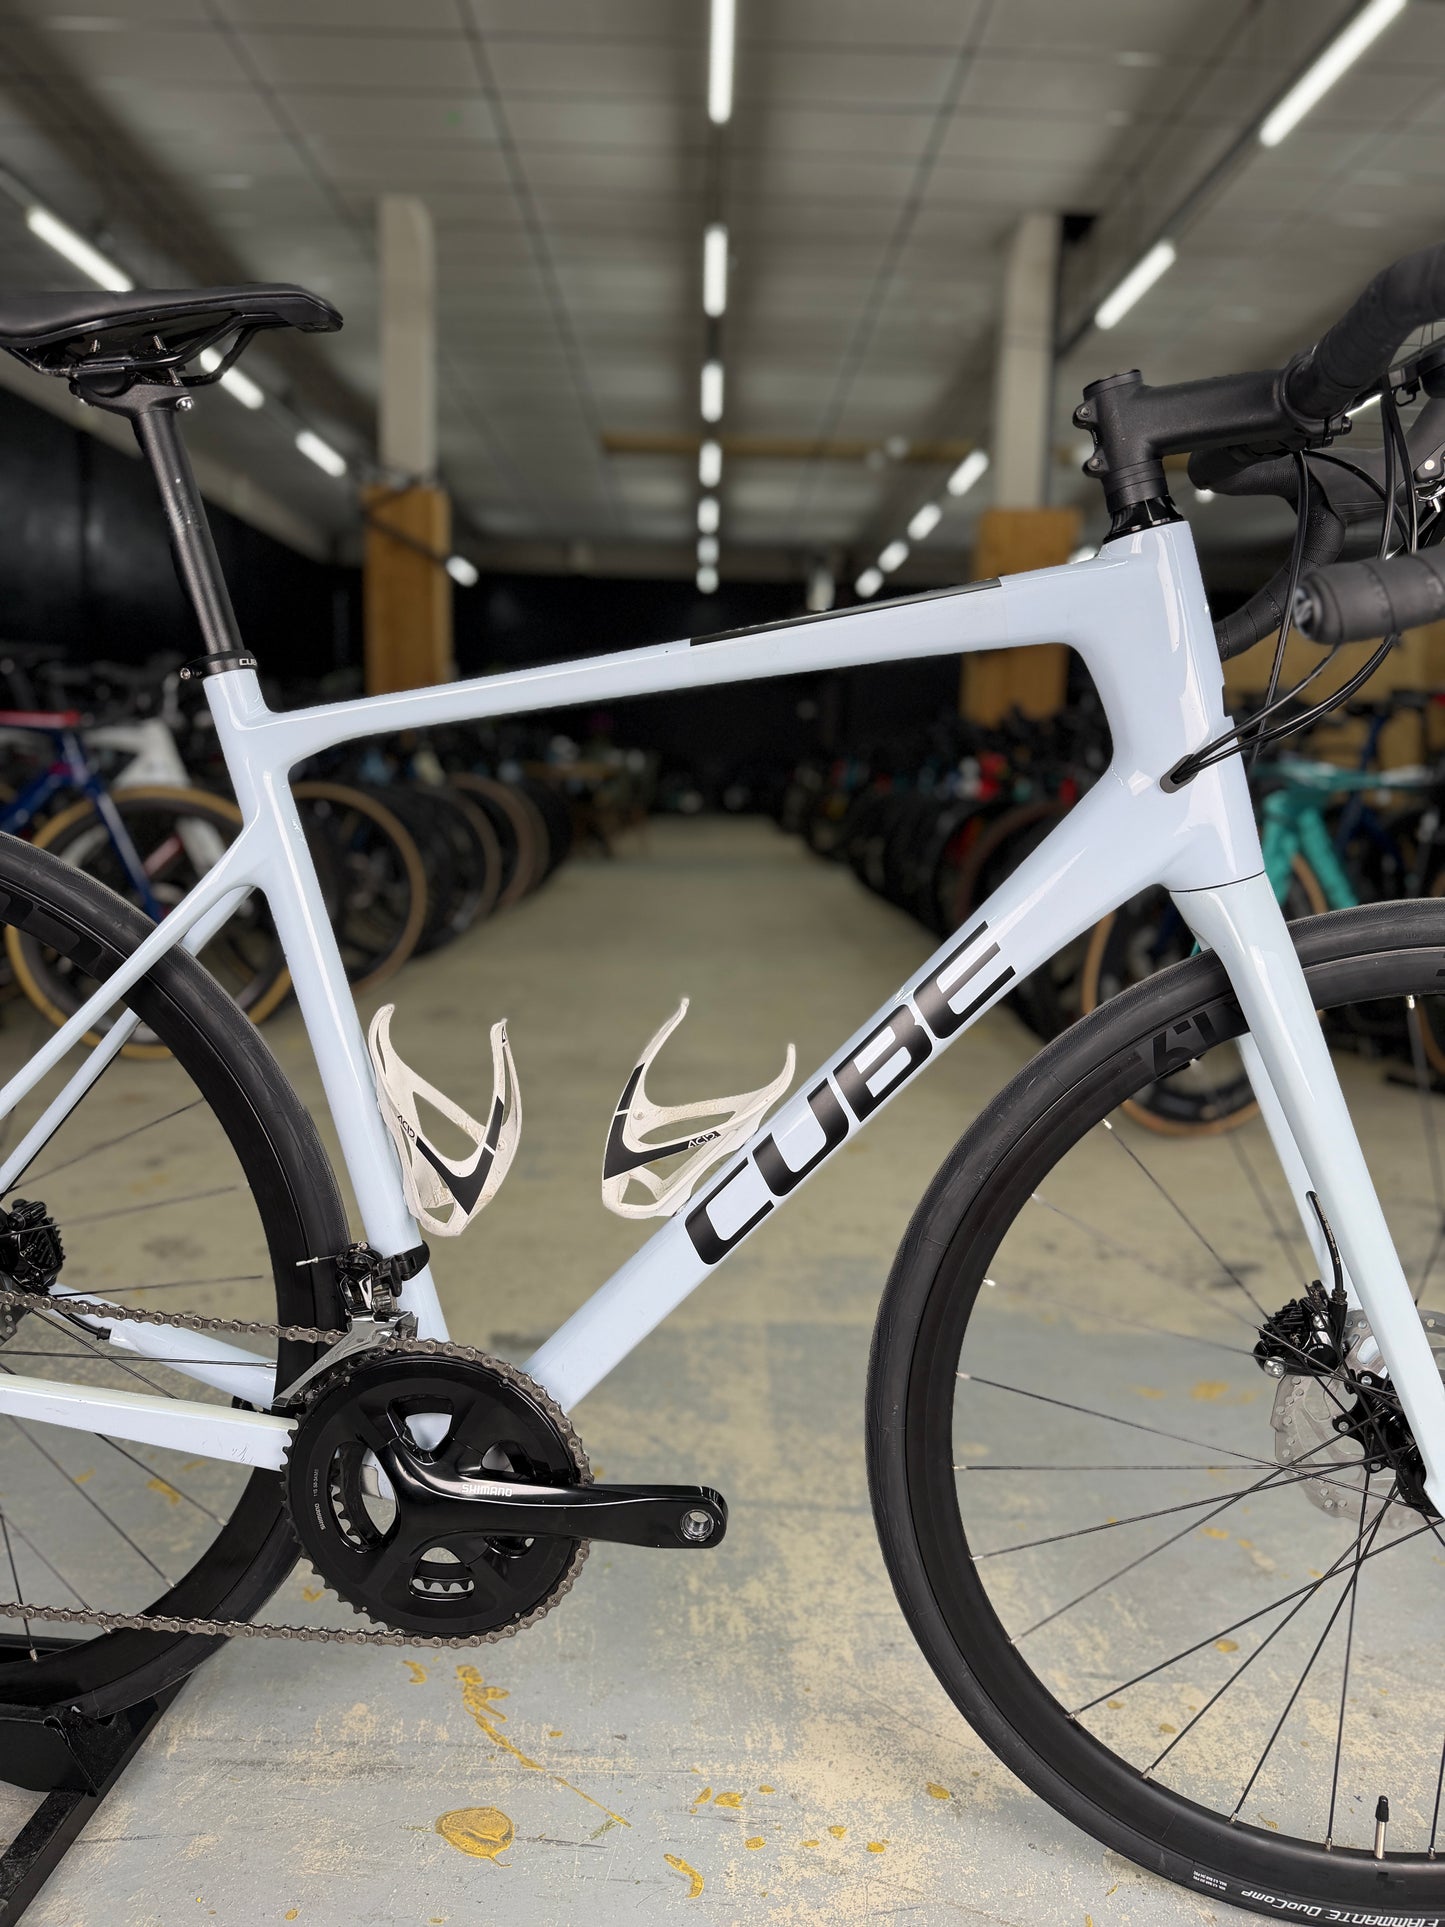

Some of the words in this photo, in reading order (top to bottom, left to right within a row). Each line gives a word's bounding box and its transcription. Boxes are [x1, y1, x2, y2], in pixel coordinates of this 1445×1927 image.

[685, 920, 1016, 1265] CUBE
[688, 1132, 716, 1149] ACID
[461, 1483, 513, 1497] SHIMANO
